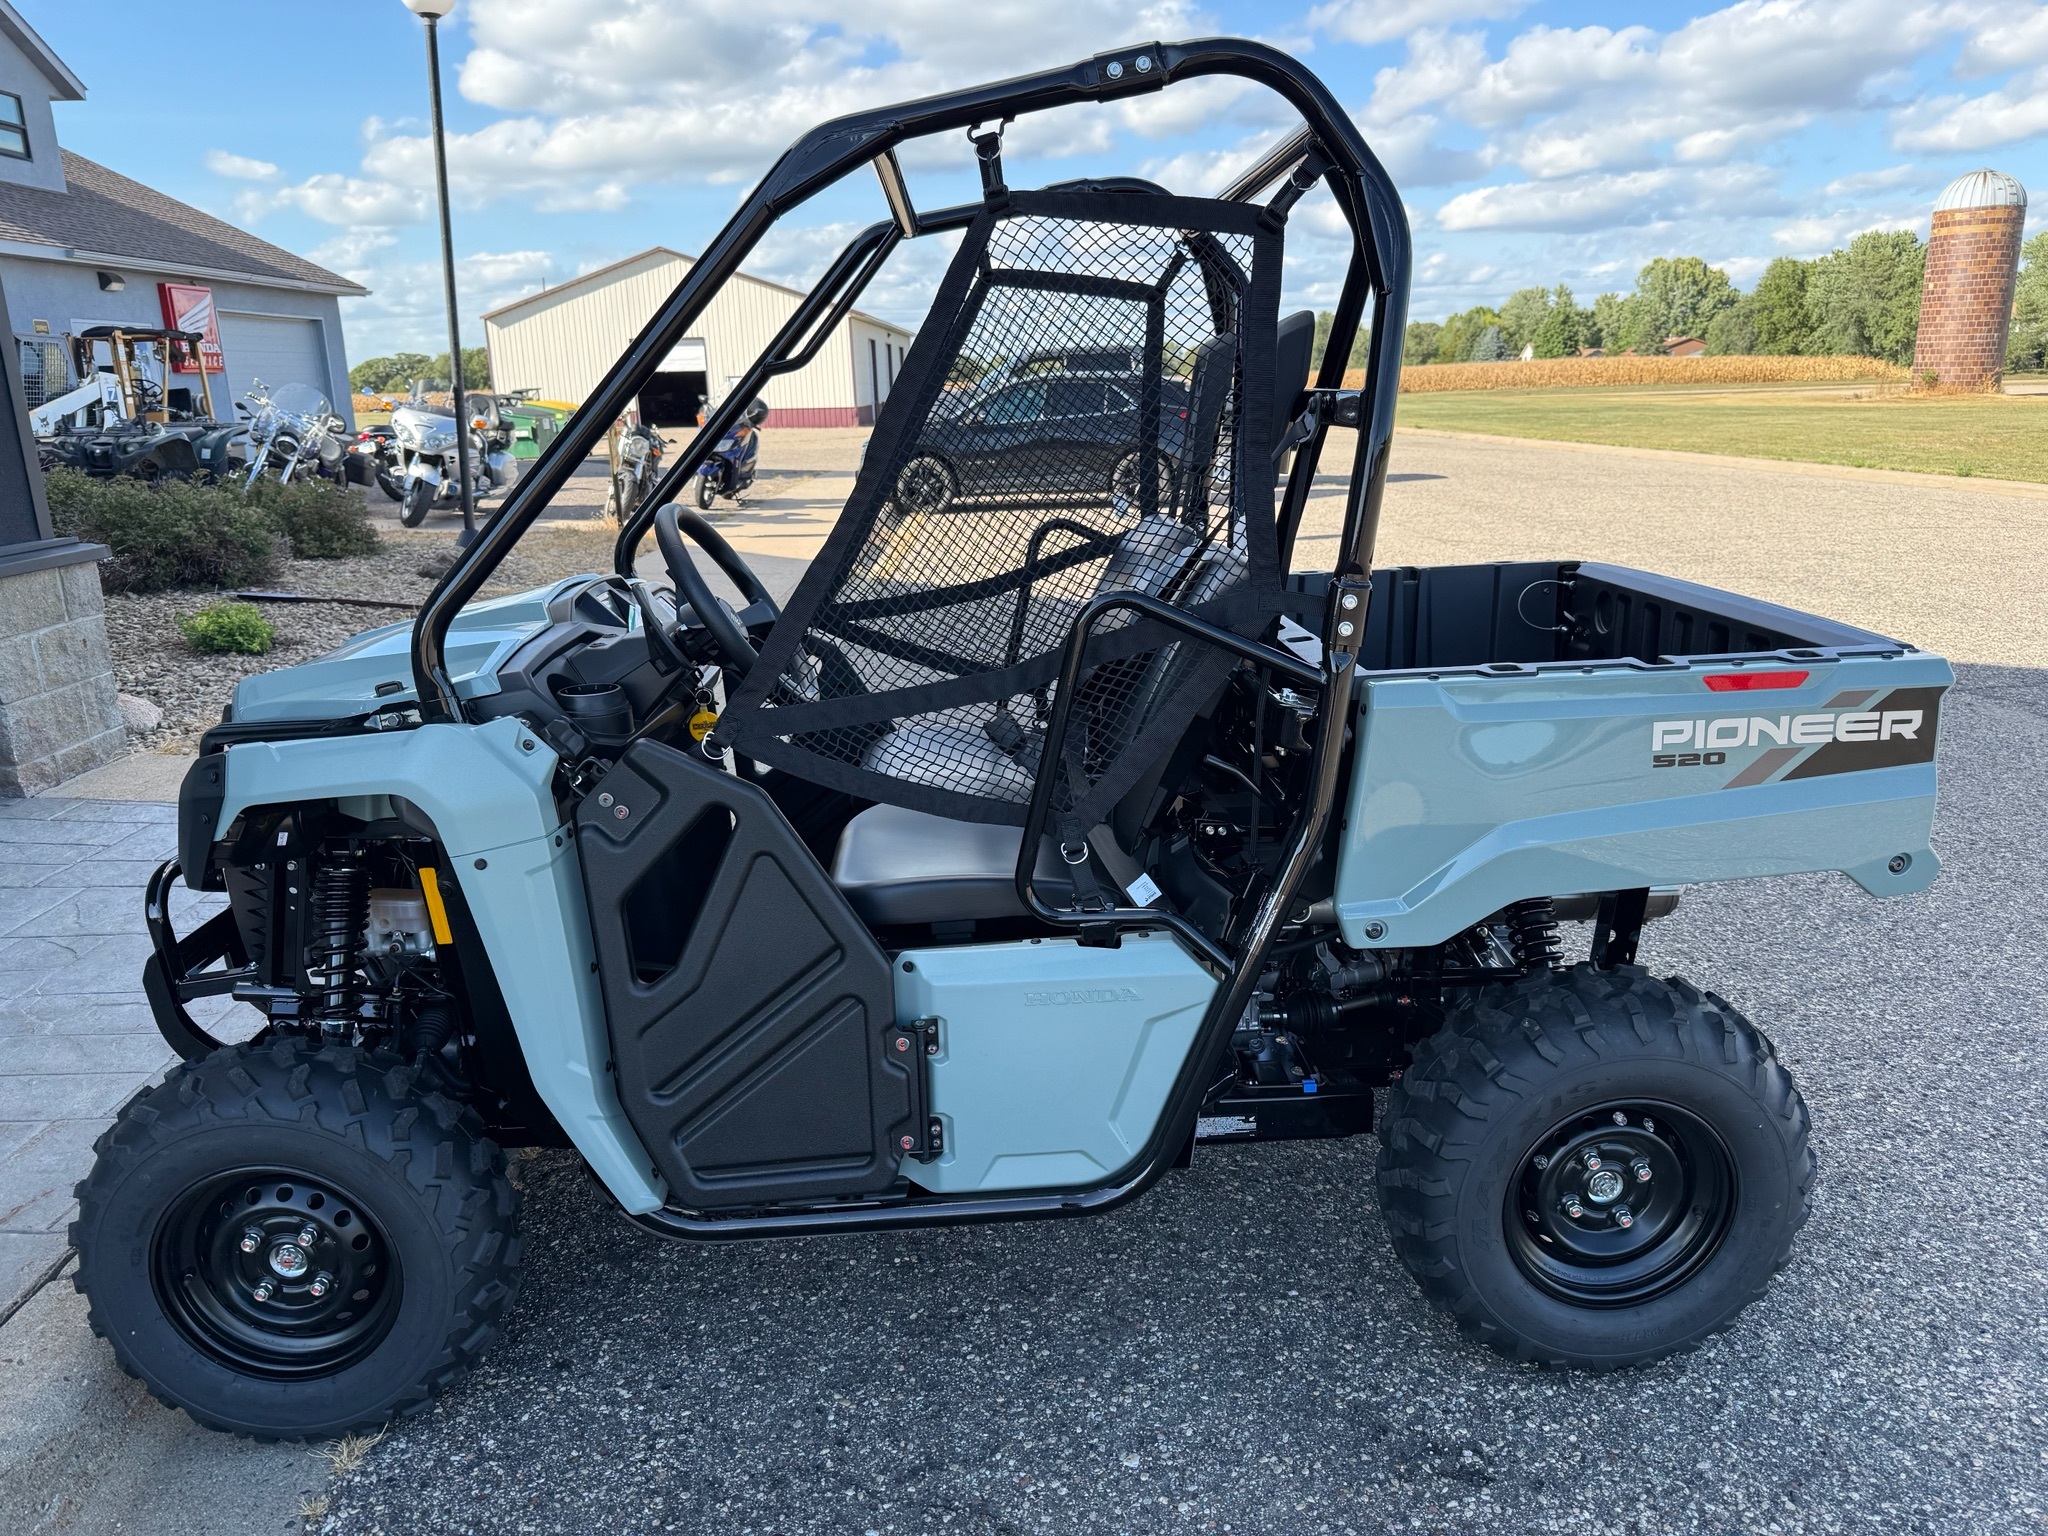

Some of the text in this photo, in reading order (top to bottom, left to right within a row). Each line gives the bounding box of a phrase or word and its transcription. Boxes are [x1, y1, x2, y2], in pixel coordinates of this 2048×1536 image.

[180, 342, 222, 353] HNDA
[184, 355, 224, 367] SEVICE
[1652, 710, 1923, 752] PIONEER
[1652, 752, 1726, 769] 520
[1024, 985, 1144, 1006] HONDA
[1472, 1080, 1598, 1250] MAXXIS
